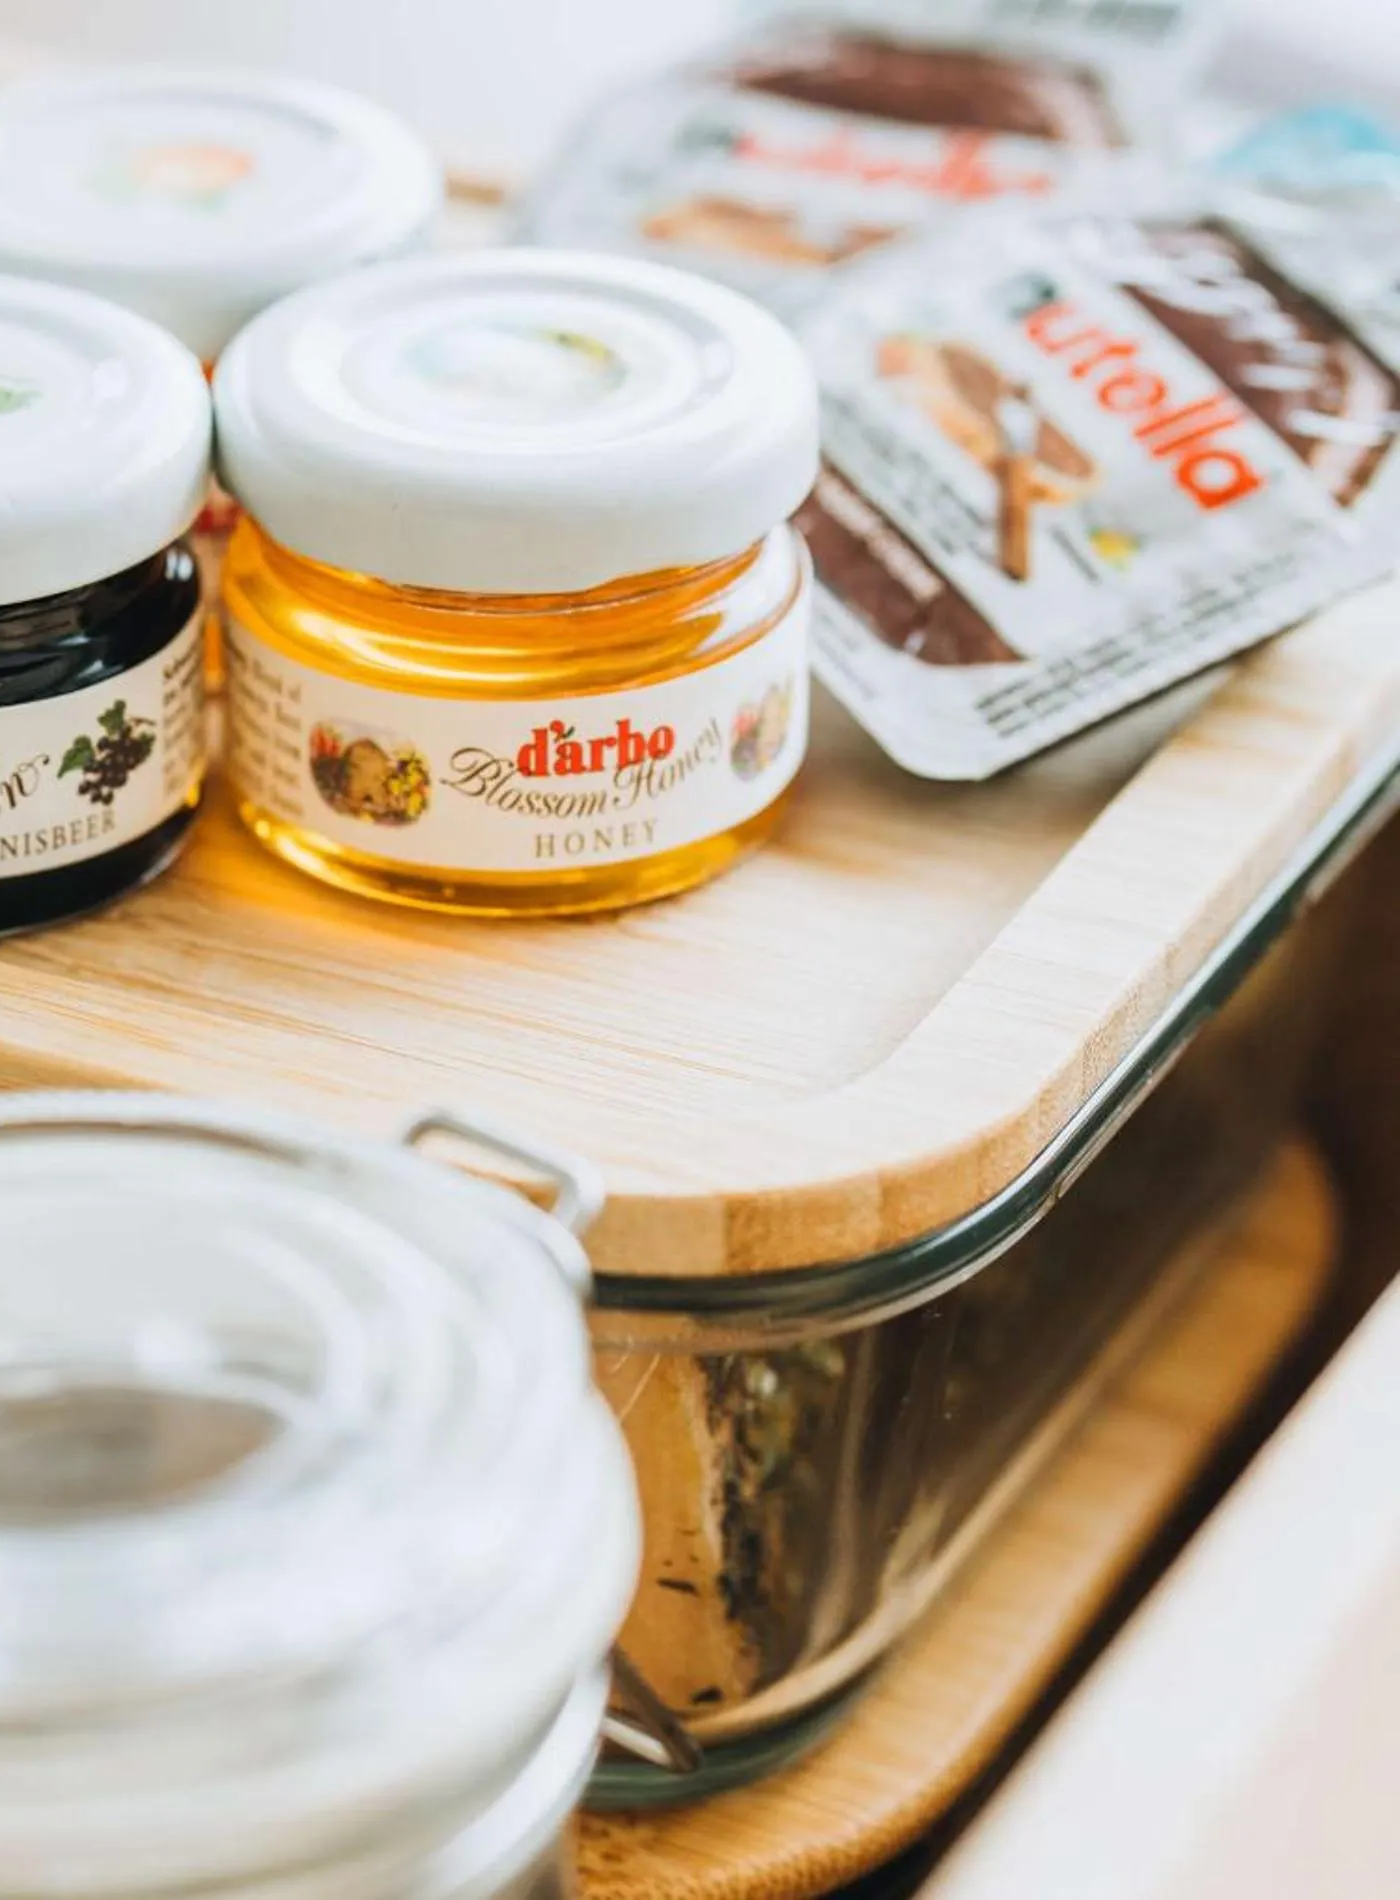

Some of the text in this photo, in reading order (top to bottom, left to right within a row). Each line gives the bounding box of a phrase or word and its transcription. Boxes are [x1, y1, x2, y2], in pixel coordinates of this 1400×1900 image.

[439, 715, 724, 819] Blossom Honey
[534, 818, 659, 859] HONEY
